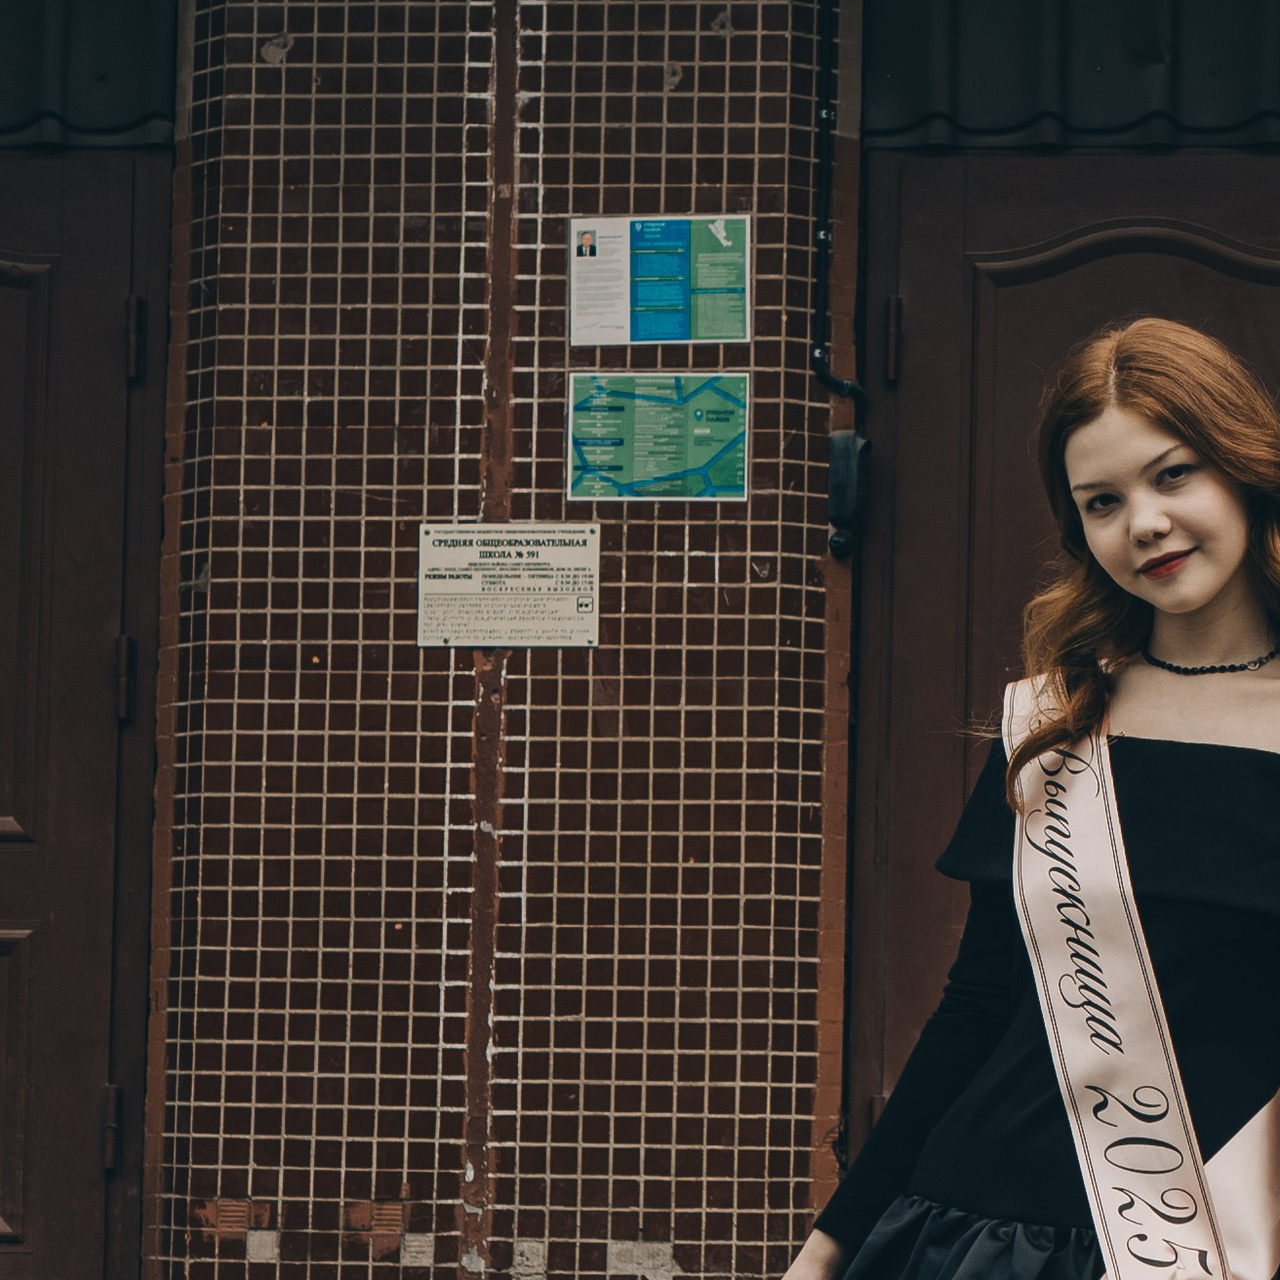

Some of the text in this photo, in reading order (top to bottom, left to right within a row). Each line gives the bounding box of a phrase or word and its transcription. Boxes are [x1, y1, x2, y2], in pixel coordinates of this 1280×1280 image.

[432, 538, 588, 549] СРЕДНЯЯ ОБЩЕОБРАЗОВАТЕЛЬНАЯ
[479, 550, 513, 559] ШКОЛА
[526, 550, 540, 559] 591
[1083, 1084, 1214, 1277] 2025
